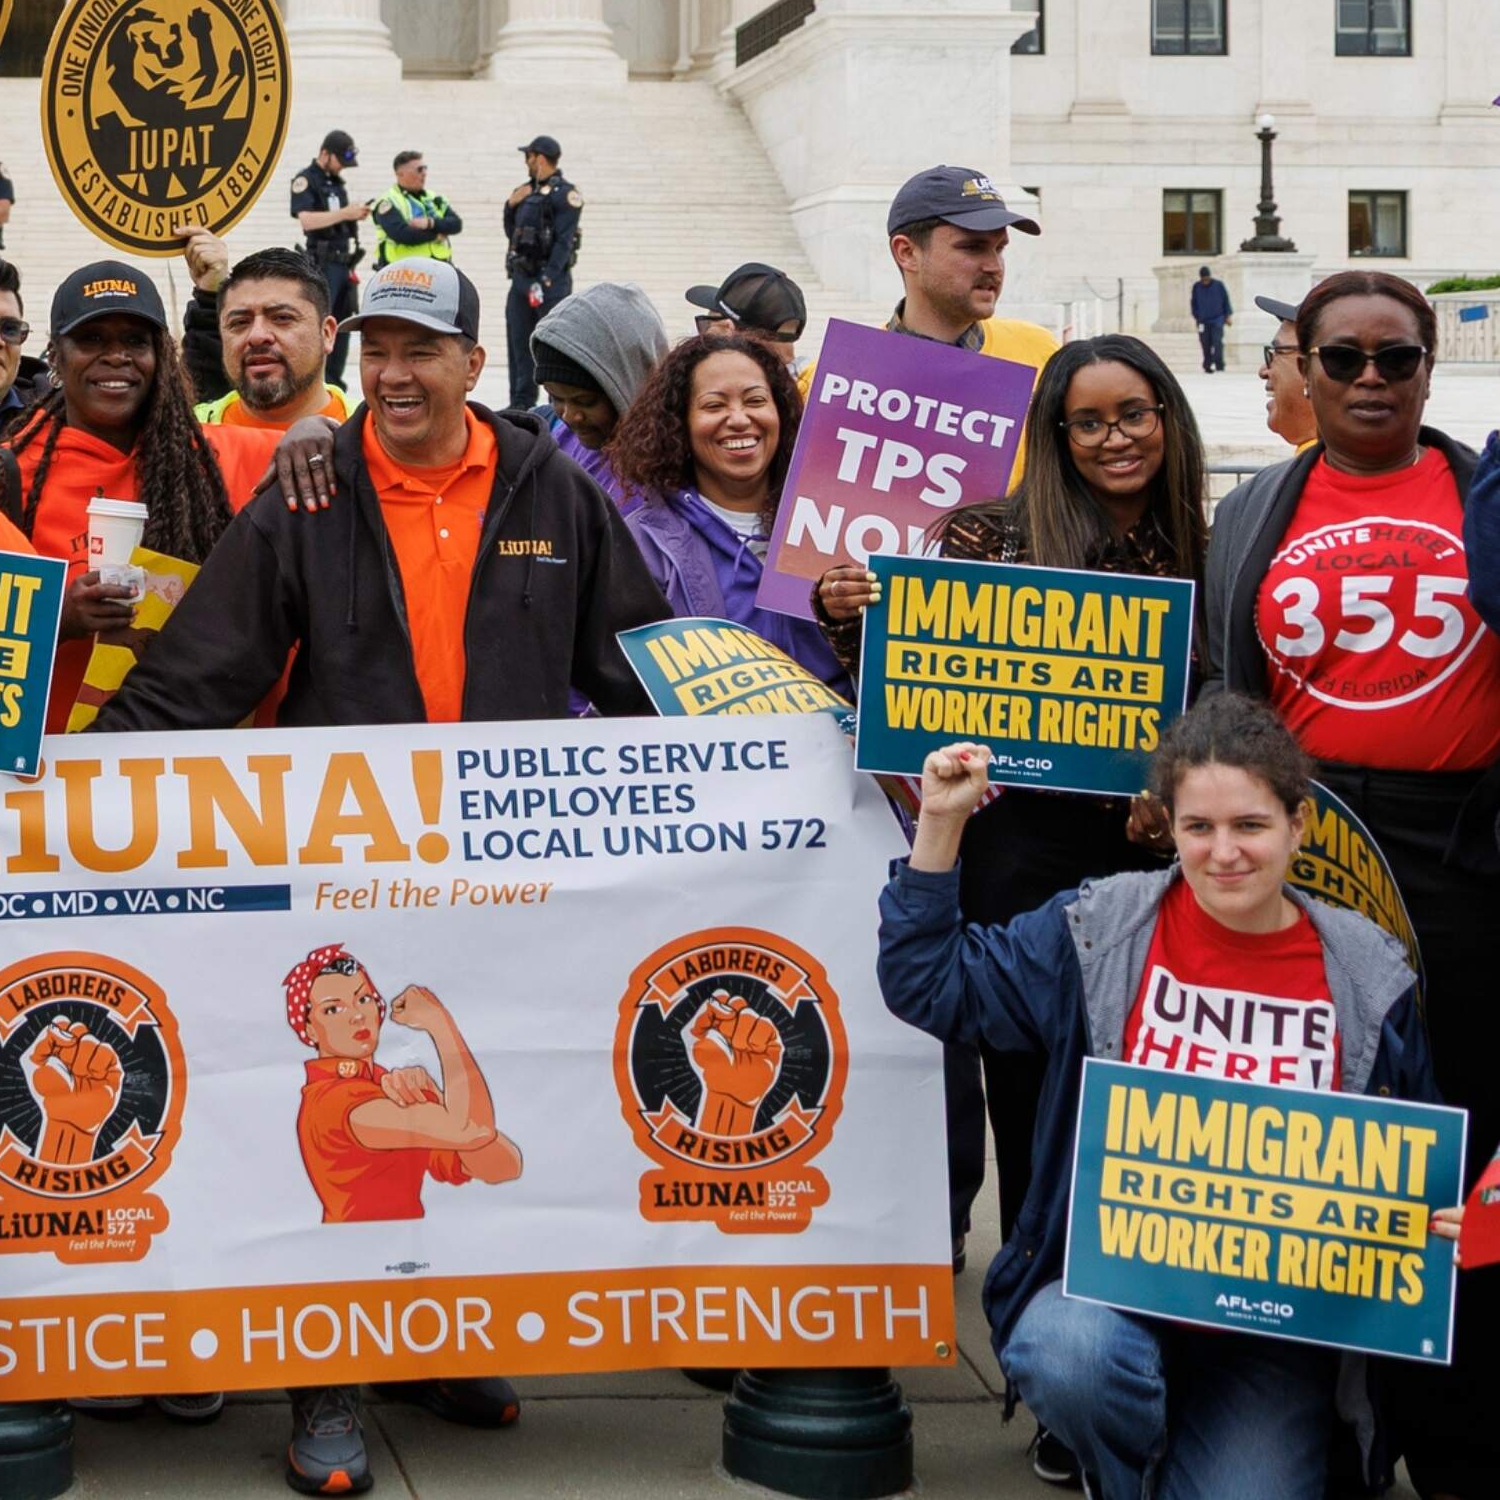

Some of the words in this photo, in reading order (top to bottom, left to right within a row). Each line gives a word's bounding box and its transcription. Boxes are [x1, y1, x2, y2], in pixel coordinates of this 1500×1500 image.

[61, 52, 89, 97] ONE
[248, 23, 277, 82] FIGHT
[129, 125, 215, 171] IUPAT
[217, 147, 262, 209] 1887
[819, 373, 1015, 449] PROTECT
[836, 429, 968, 508] TPS
[1285, 527, 1371, 565] UNITE
[1315, 552, 1417, 571] LOCAL
[887, 575, 1170, 659] IMMIGRANT
[1272, 574, 1470, 659] 355
[690, 665, 816, 705] RIGHT
[901, 650, 1052, 685] RIGHTS
[1071, 664, 1150, 695] ARE
[1341, 668, 1429, 698] FLORIDA
[717, 682, 839, 716] ORKER
[885, 683, 1032, 741] WORKER
[1038, 700, 1161, 753] RIGHTS
[457, 745, 605, 779] PUBLIC
[618, 740, 789, 774] SERVICE
[988, 754, 1053, 771] AFL-CIO
[460, 783, 695, 820] EMPLOYEES
[463, 827, 593, 861] LOCAL
[603, 821, 747, 856] UNION
[760, 817, 826, 850] 572
[53, 891, 98, 915] MD
[123, 889, 161, 912] VA
[186, 887, 225, 911] NC
[315, 879, 378, 911] Feel
[388, 879, 440, 909] the
[450, 878, 554, 907] Power
[668, 949, 786, 986] LABORERS
[7, 973, 127, 1010] LABORERS
[1154, 974, 1330, 1051] UNITE
[338, 1061, 356, 1075] 572
[1105, 1084, 1436, 1197] IMMIGRANT
[653, 1180, 765, 1208] LiUNA!
[768, 1180, 815, 1193] LOCAL
[767, 1193, 797, 1207] 572
[1119, 1169, 1294, 1218] RIGHTS
[1316, 1199, 1411, 1239] ARE
[107, 1207, 154, 1221] LOCAL
[107, 1221, 136, 1235] 572
[729, 1210, 749, 1221] Feel
[749, 1210, 765, 1220] the
[767, 1209, 798, 1221] Power
[68, 1240, 88, 1251] Feel
[89, 1239, 105, 1250] the
[1099, 1203, 1272, 1283] WORKER
[1277, 1235, 1424, 1305] RIGHTS
[241, 1297, 496, 1364] HONOR
[567, 1285, 930, 1347] STRENGTH
[1215, 1293, 1294, 1318] AFL-CIO
